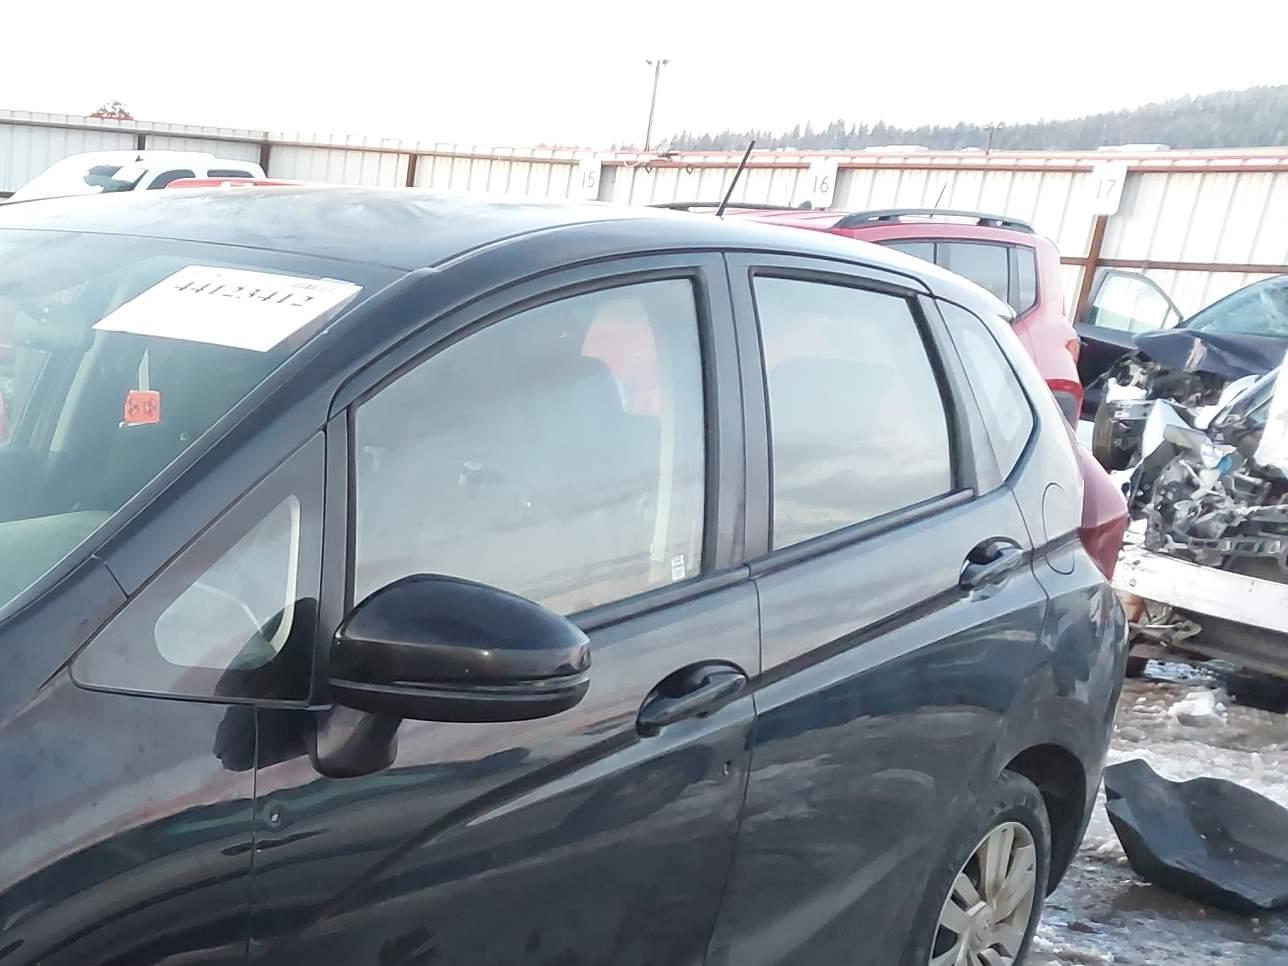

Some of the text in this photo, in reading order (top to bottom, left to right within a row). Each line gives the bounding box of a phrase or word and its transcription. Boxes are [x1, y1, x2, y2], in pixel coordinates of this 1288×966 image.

[581, 170, 597, 190] 15
[812, 175, 830, 193] 16
[1095, 177, 1117, 200] 17
